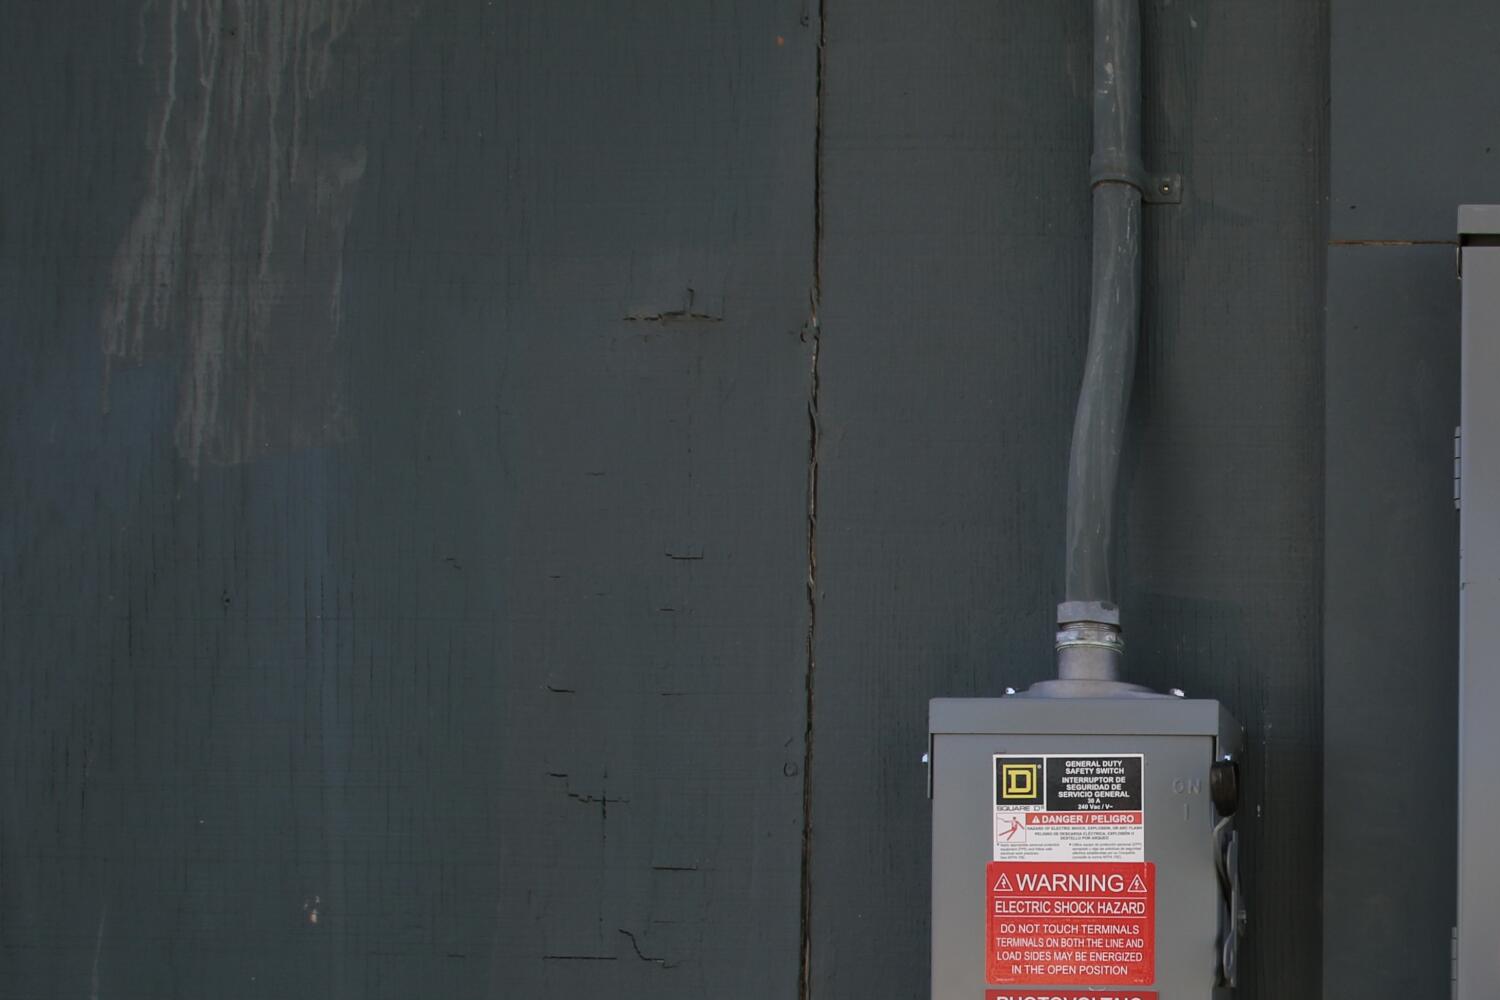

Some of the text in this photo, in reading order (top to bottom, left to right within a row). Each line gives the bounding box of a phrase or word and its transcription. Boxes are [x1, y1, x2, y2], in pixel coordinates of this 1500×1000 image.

[1092, 815, 1134, 823] PELIGRO
[1016, 874, 1123, 892] WARNING
[995, 901, 1145, 914] ELECTRIC SHOCK HAZARD
[1001, 924, 1139, 935] DO NOT TOUCH TERMINALS
[996, 938, 1143, 948] TERMINALS ON BOTH THE LINE AND
[997, 952, 1142, 962] LOAD SIDES MAY BE ENERGIZED
[1012, 965, 1127, 975] IN THE OPEN POSITION
